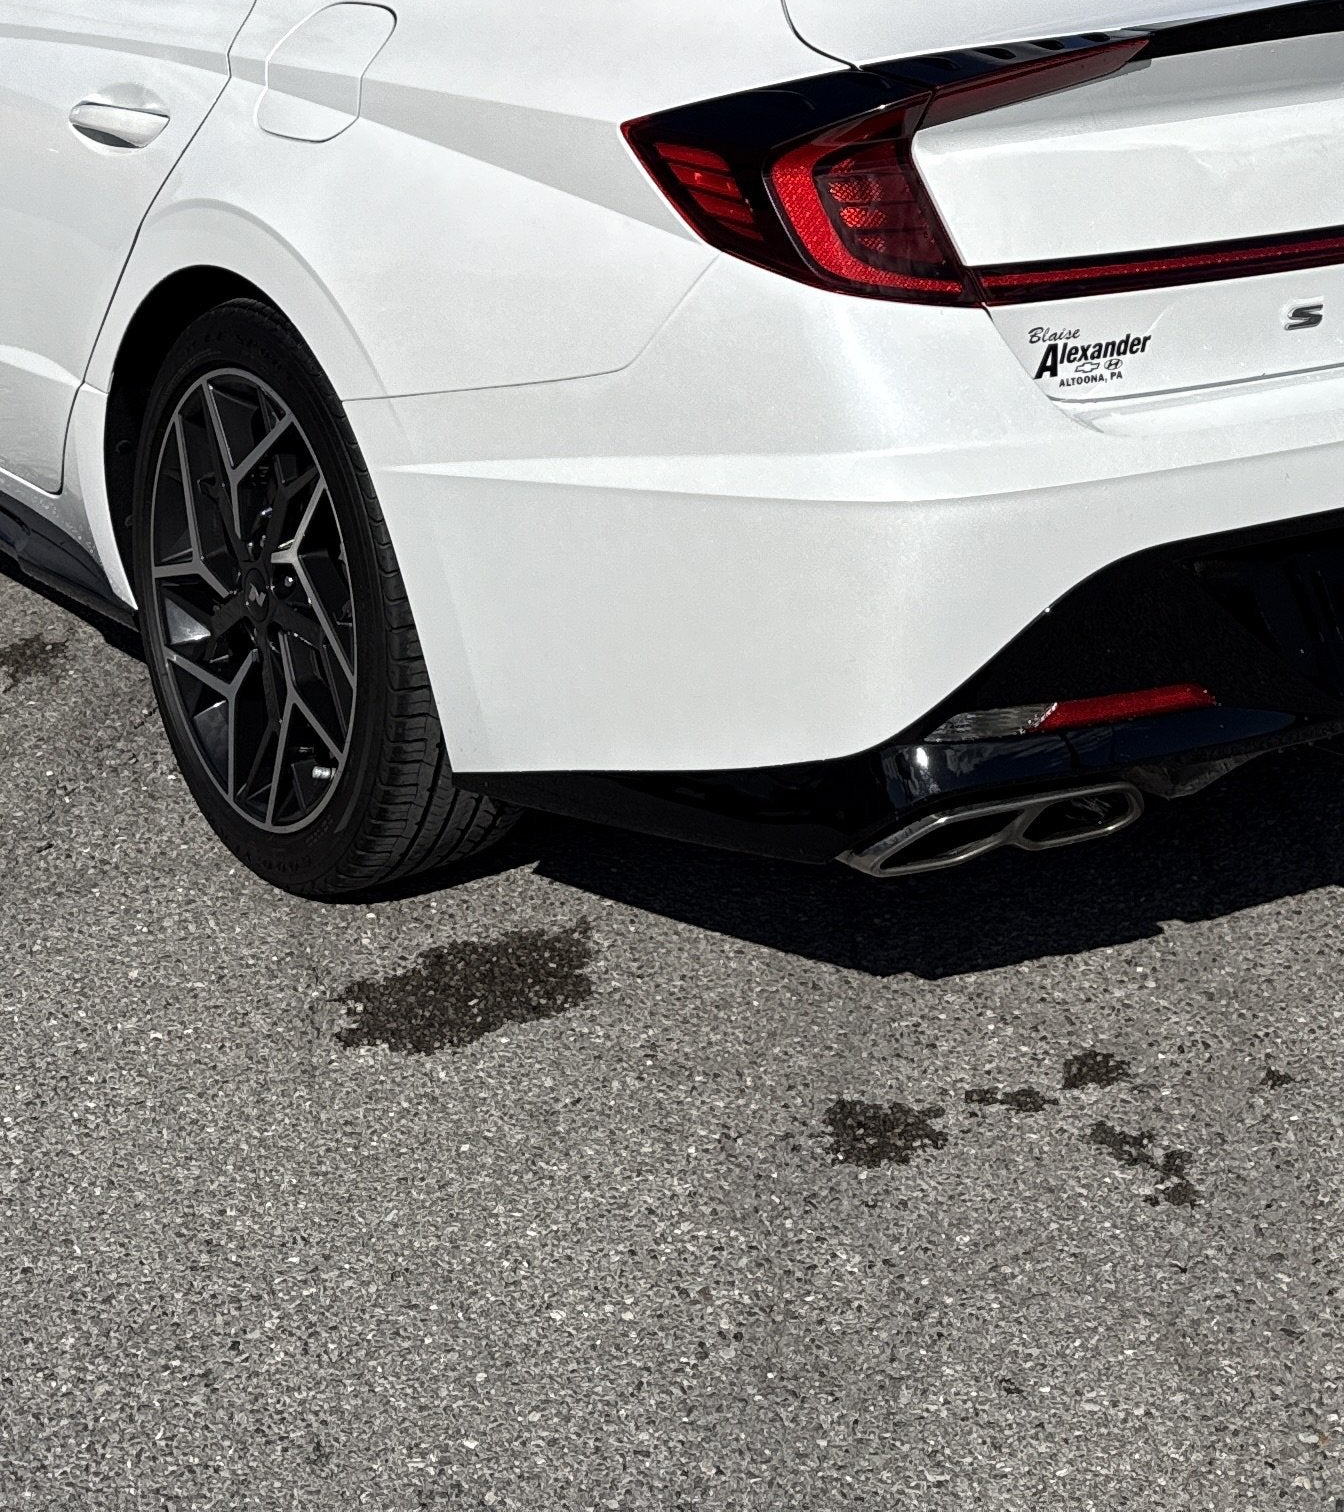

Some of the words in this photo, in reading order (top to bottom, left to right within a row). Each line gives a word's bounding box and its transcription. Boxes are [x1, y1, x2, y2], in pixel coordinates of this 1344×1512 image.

[1027, 326, 1080, 344] Blaise
[1033, 333, 1152, 380] Alexander
[1059, 374, 1108, 388] ALTOONA,
[1110, 371, 1123, 380] PA
